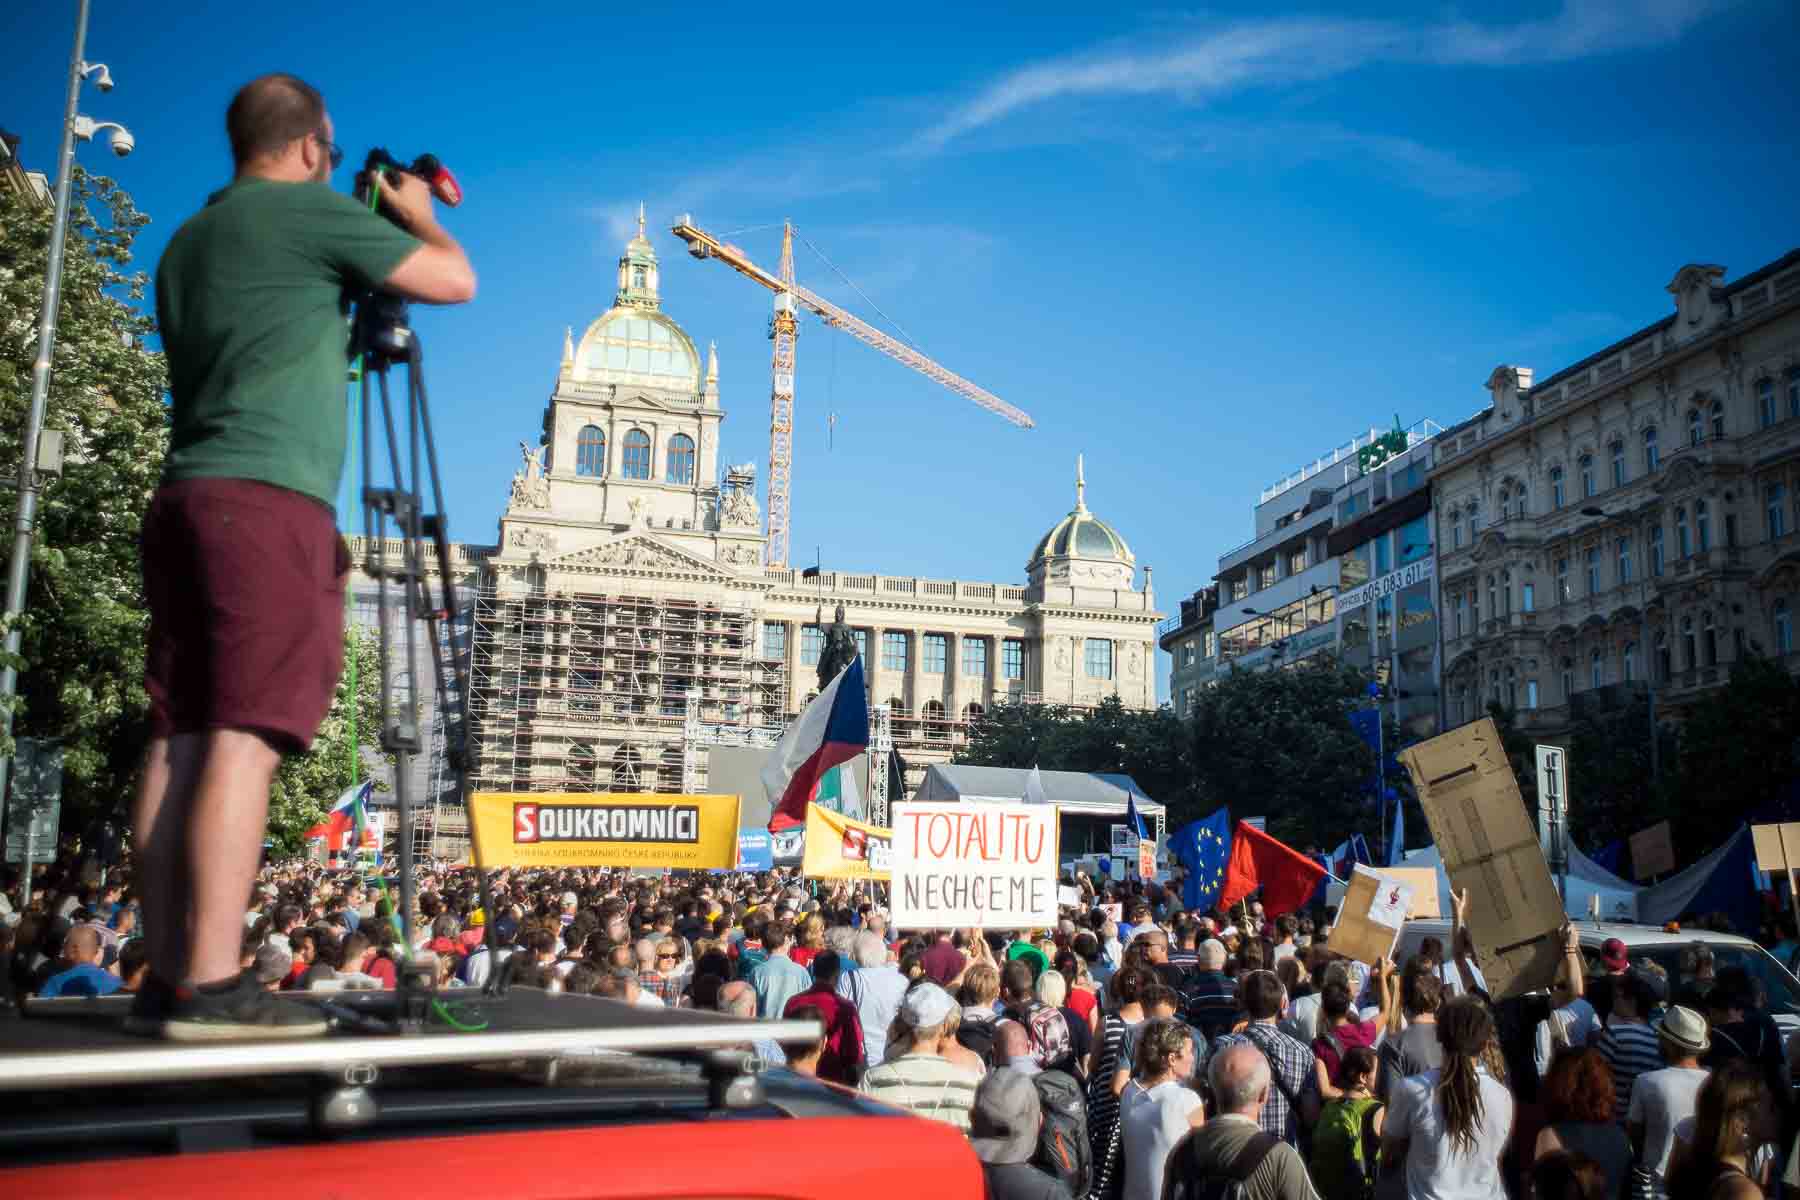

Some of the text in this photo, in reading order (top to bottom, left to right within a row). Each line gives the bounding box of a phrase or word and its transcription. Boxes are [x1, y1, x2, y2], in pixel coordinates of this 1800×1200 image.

[1383, 572, 1402, 593] 083
[1406, 564, 1421, 585] 611
[518, 804, 697, 840] SOUKROMNÍCI
[903, 811, 1045, 864] TOTALITU
[904, 873, 1048, 914] NECHCEME
